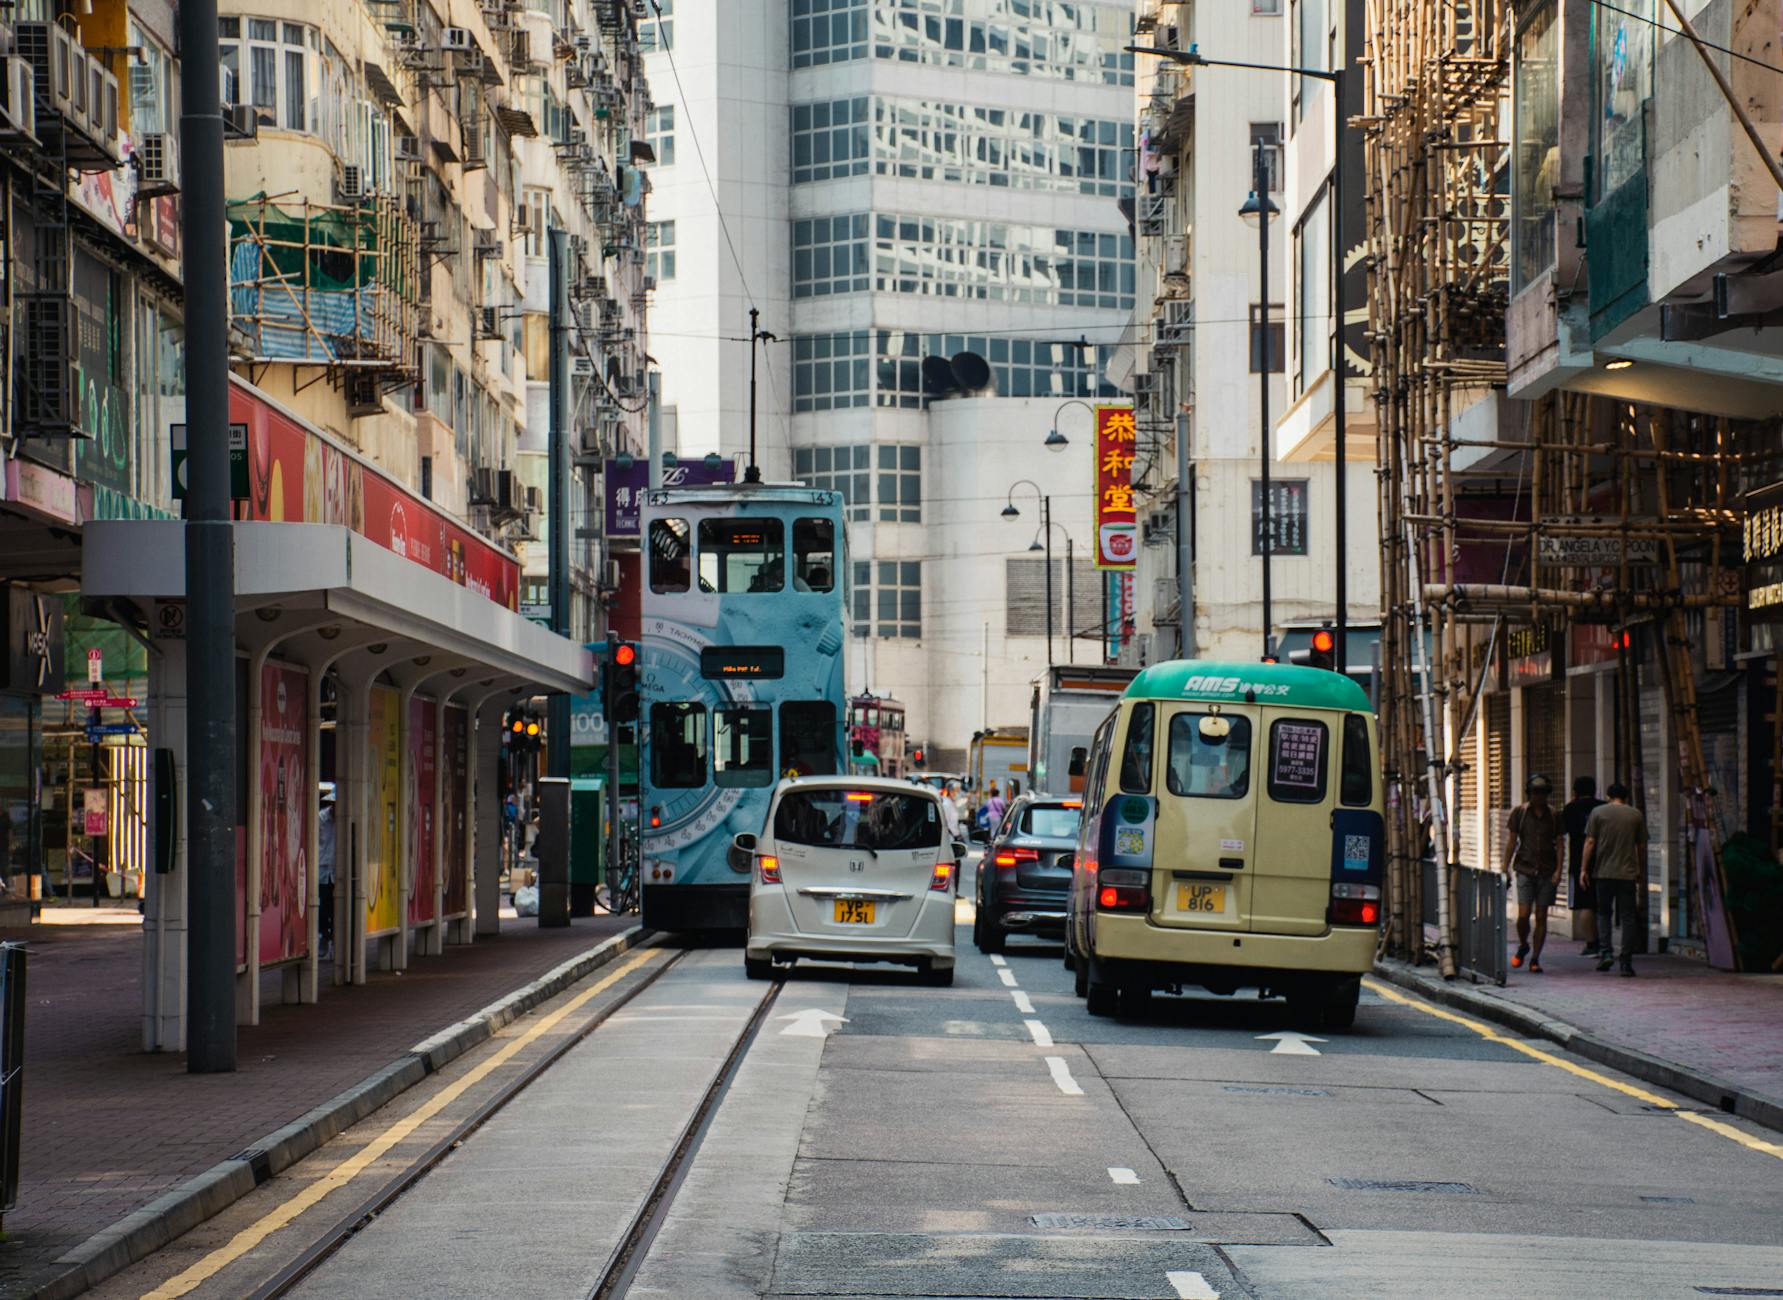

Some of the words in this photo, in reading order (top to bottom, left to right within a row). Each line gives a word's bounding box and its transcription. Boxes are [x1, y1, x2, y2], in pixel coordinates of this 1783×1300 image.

[1102, 413, 1136, 514] 恭和堂
[647, 492, 669, 506] 143
[810, 491, 834, 506] 143
[1559, 539, 1600, 552] ANGELA
[1184, 676, 1240, 693] AMS
[1191, 886, 1212, 898] UP
[846, 900, 864, 912] VP
[1188, 897, 1214, 911] 816
